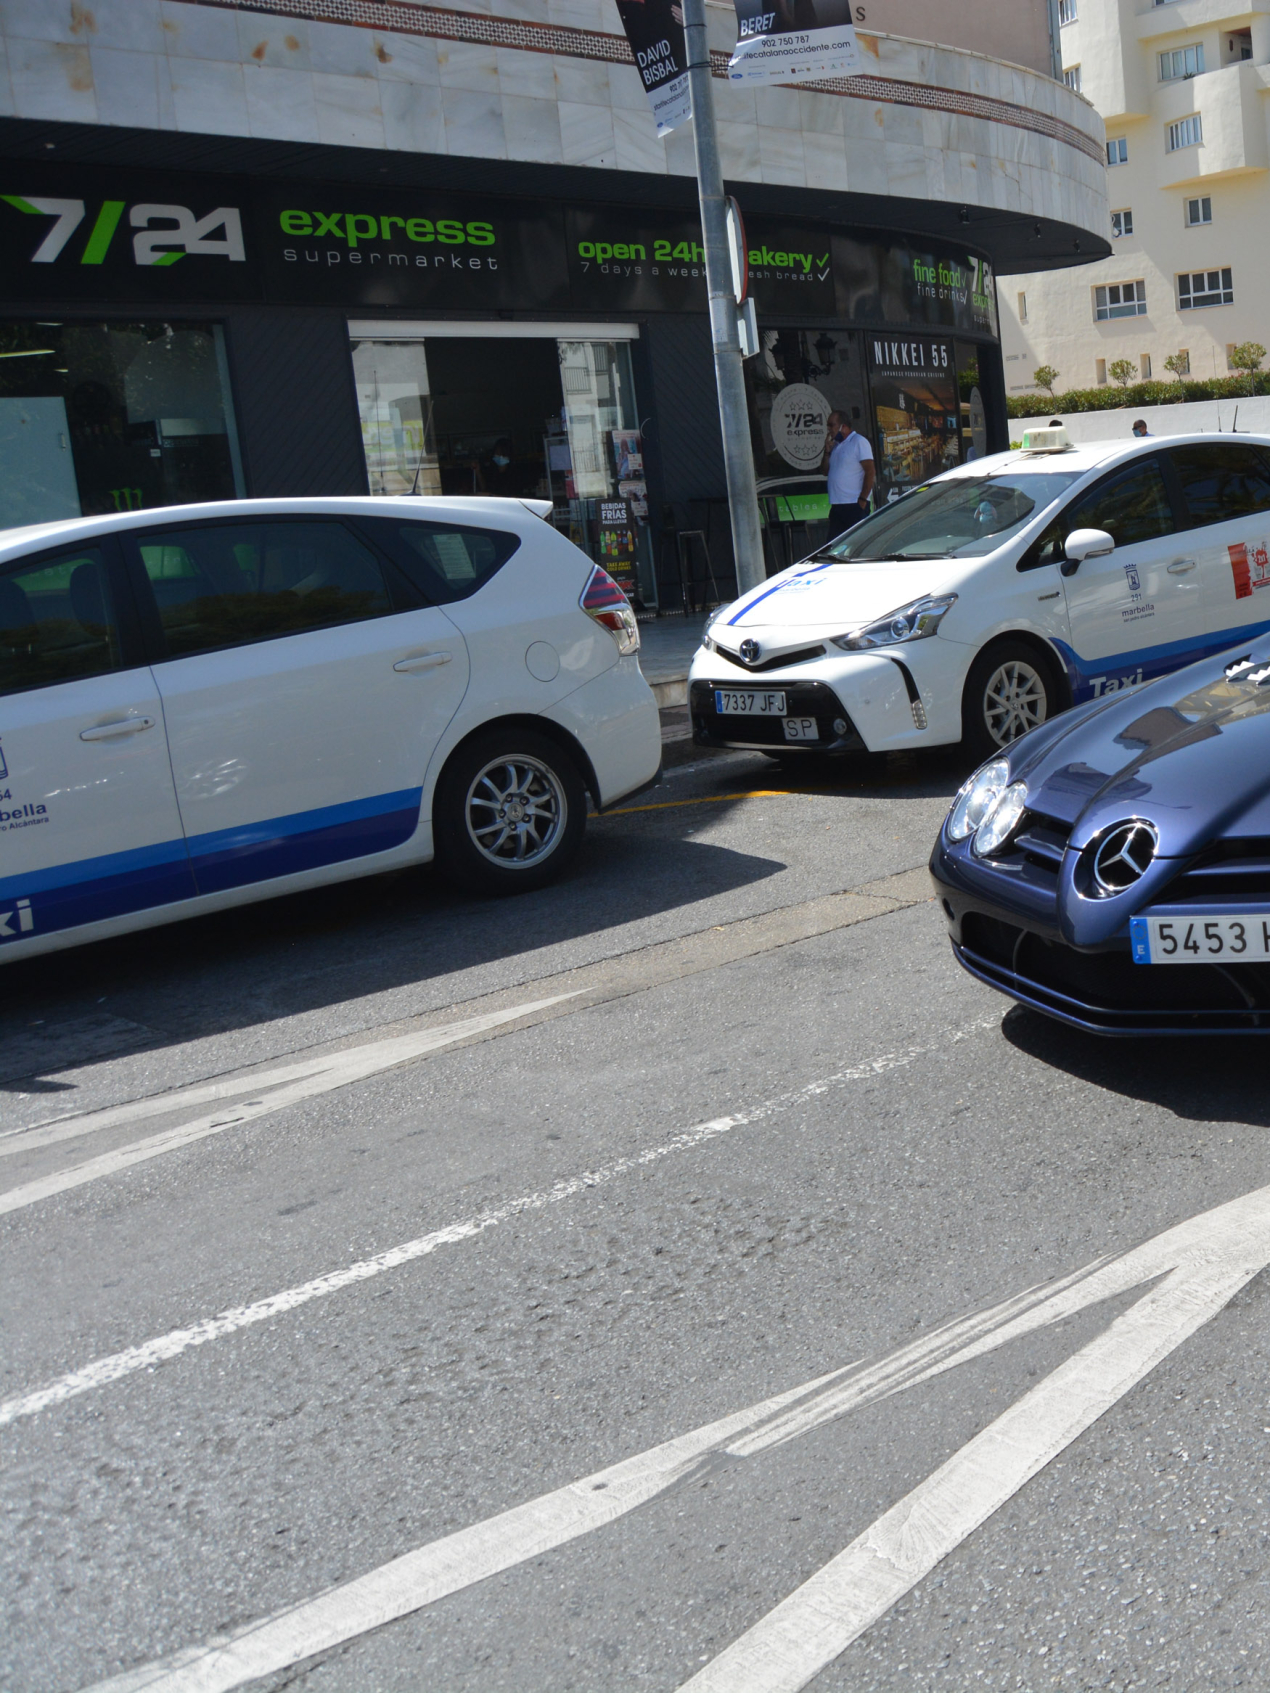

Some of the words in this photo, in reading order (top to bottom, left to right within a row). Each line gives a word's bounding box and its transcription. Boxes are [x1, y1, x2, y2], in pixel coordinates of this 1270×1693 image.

[740, 12, 776, 37] BERET
[761, 39, 776, 49] 902
[778, 37, 794, 47] 750
[795, 35, 810, 44] 787
[636, 40, 671, 68] DAVID
[642, 58, 678, 86] BISBAL
[0, 194, 247, 266] 7/24
[279, 209, 496, 247] express
[283, 248, 498, 270] supermarket
[578, 241, 646, 264] open
[747, 245, 813, 273] akery
[580, 262, 590, 273] 7
[600, 261, 643, 277] days
[651, 266, 660, 276] a
[747, 270, 771, 279] esh
[776, 271, 813, 281] bread
[913, 259, 937, 284] fine
[938, 262, 961, 288] food
[917, 282, 936, 298] fine
[938, 285, 964, 303] drinks
[873, 341, 925, 367] NIKKEI
[931, 344, 948, 368] 55
[787, 428, 824, 437] express
[601, 502, 627, 511] BEBIDAS
[601, 509, 627, 520] FRÍAS
[1130, 593, 1142, 602] 291
[1121, 604, 1155, 617] marbella
[1089, 668, 1143, 698] Taxi
[723, 694, 755, 713] 7337
[760, 693, 785, 713] JFJ
[786, 719, 812, 738] SP
[0, 803, 47, 822] bella
[9, 816, 49, 830] Alcántara
[1158, 921, 1248, 955] 5453
[1138, 944, 1146, 955] E
